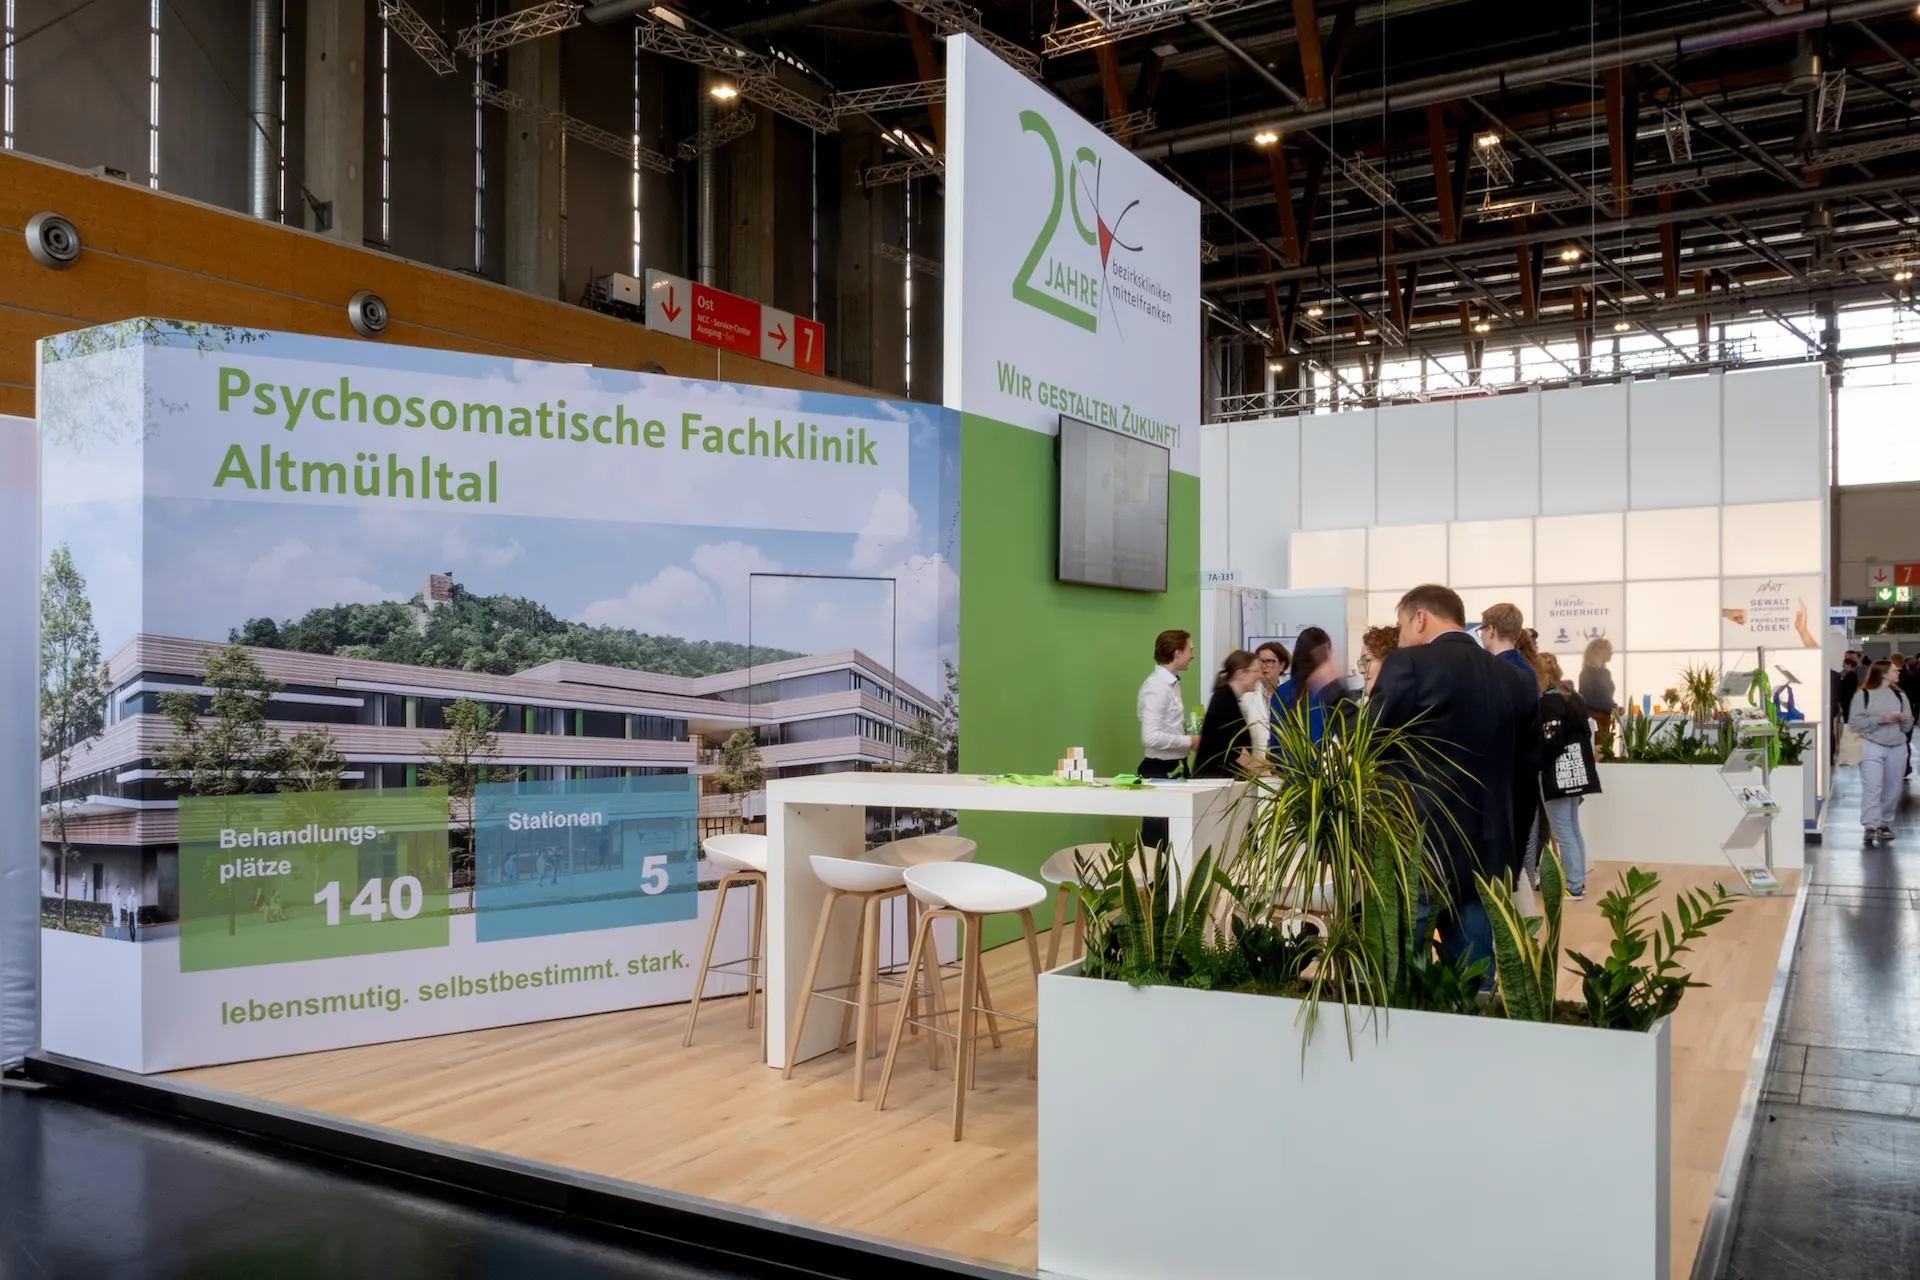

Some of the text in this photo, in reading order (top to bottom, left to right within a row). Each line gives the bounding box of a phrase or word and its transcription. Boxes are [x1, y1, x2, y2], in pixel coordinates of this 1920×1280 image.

[1045, 257, 1097, 309] JAHRE
[1112, 258, 1172, 304] bezirkskliniken
[697, 295, 714, 311] Ost
[1112, 284, 1172, 325] mittelfranken
[697, 313, 751, 337] NCC Service-Center
[697, 324, 722, 340] Ausgang
[803, 328, 814, 363] 7
[218, 367, 878, 465] Psychosomatische Fachklinik
[213, 443, 498, 503] Altmühltal
[1207, 573, 1234, 582] 7A-331
[1903, 566, 1913, 583] 7
[1549, 608, 1609, 617] SICHERHEIT
[1556, 759, 1585, 771] FRESSE
[1556, 770, 1572, 780] UND
[1557, 775, 1589, 789] WEITER
[507, 810, 602, 832] Stationen
[219, 822, 386, 850] Behandlungs-
[219, 857, 292, 885] plätze
[641, 854, 669, 895] 5
[313, 875, 423, 926] 140
[220, 950, 691, 1026] lebensmutig. selbstbestimmt. stark.
